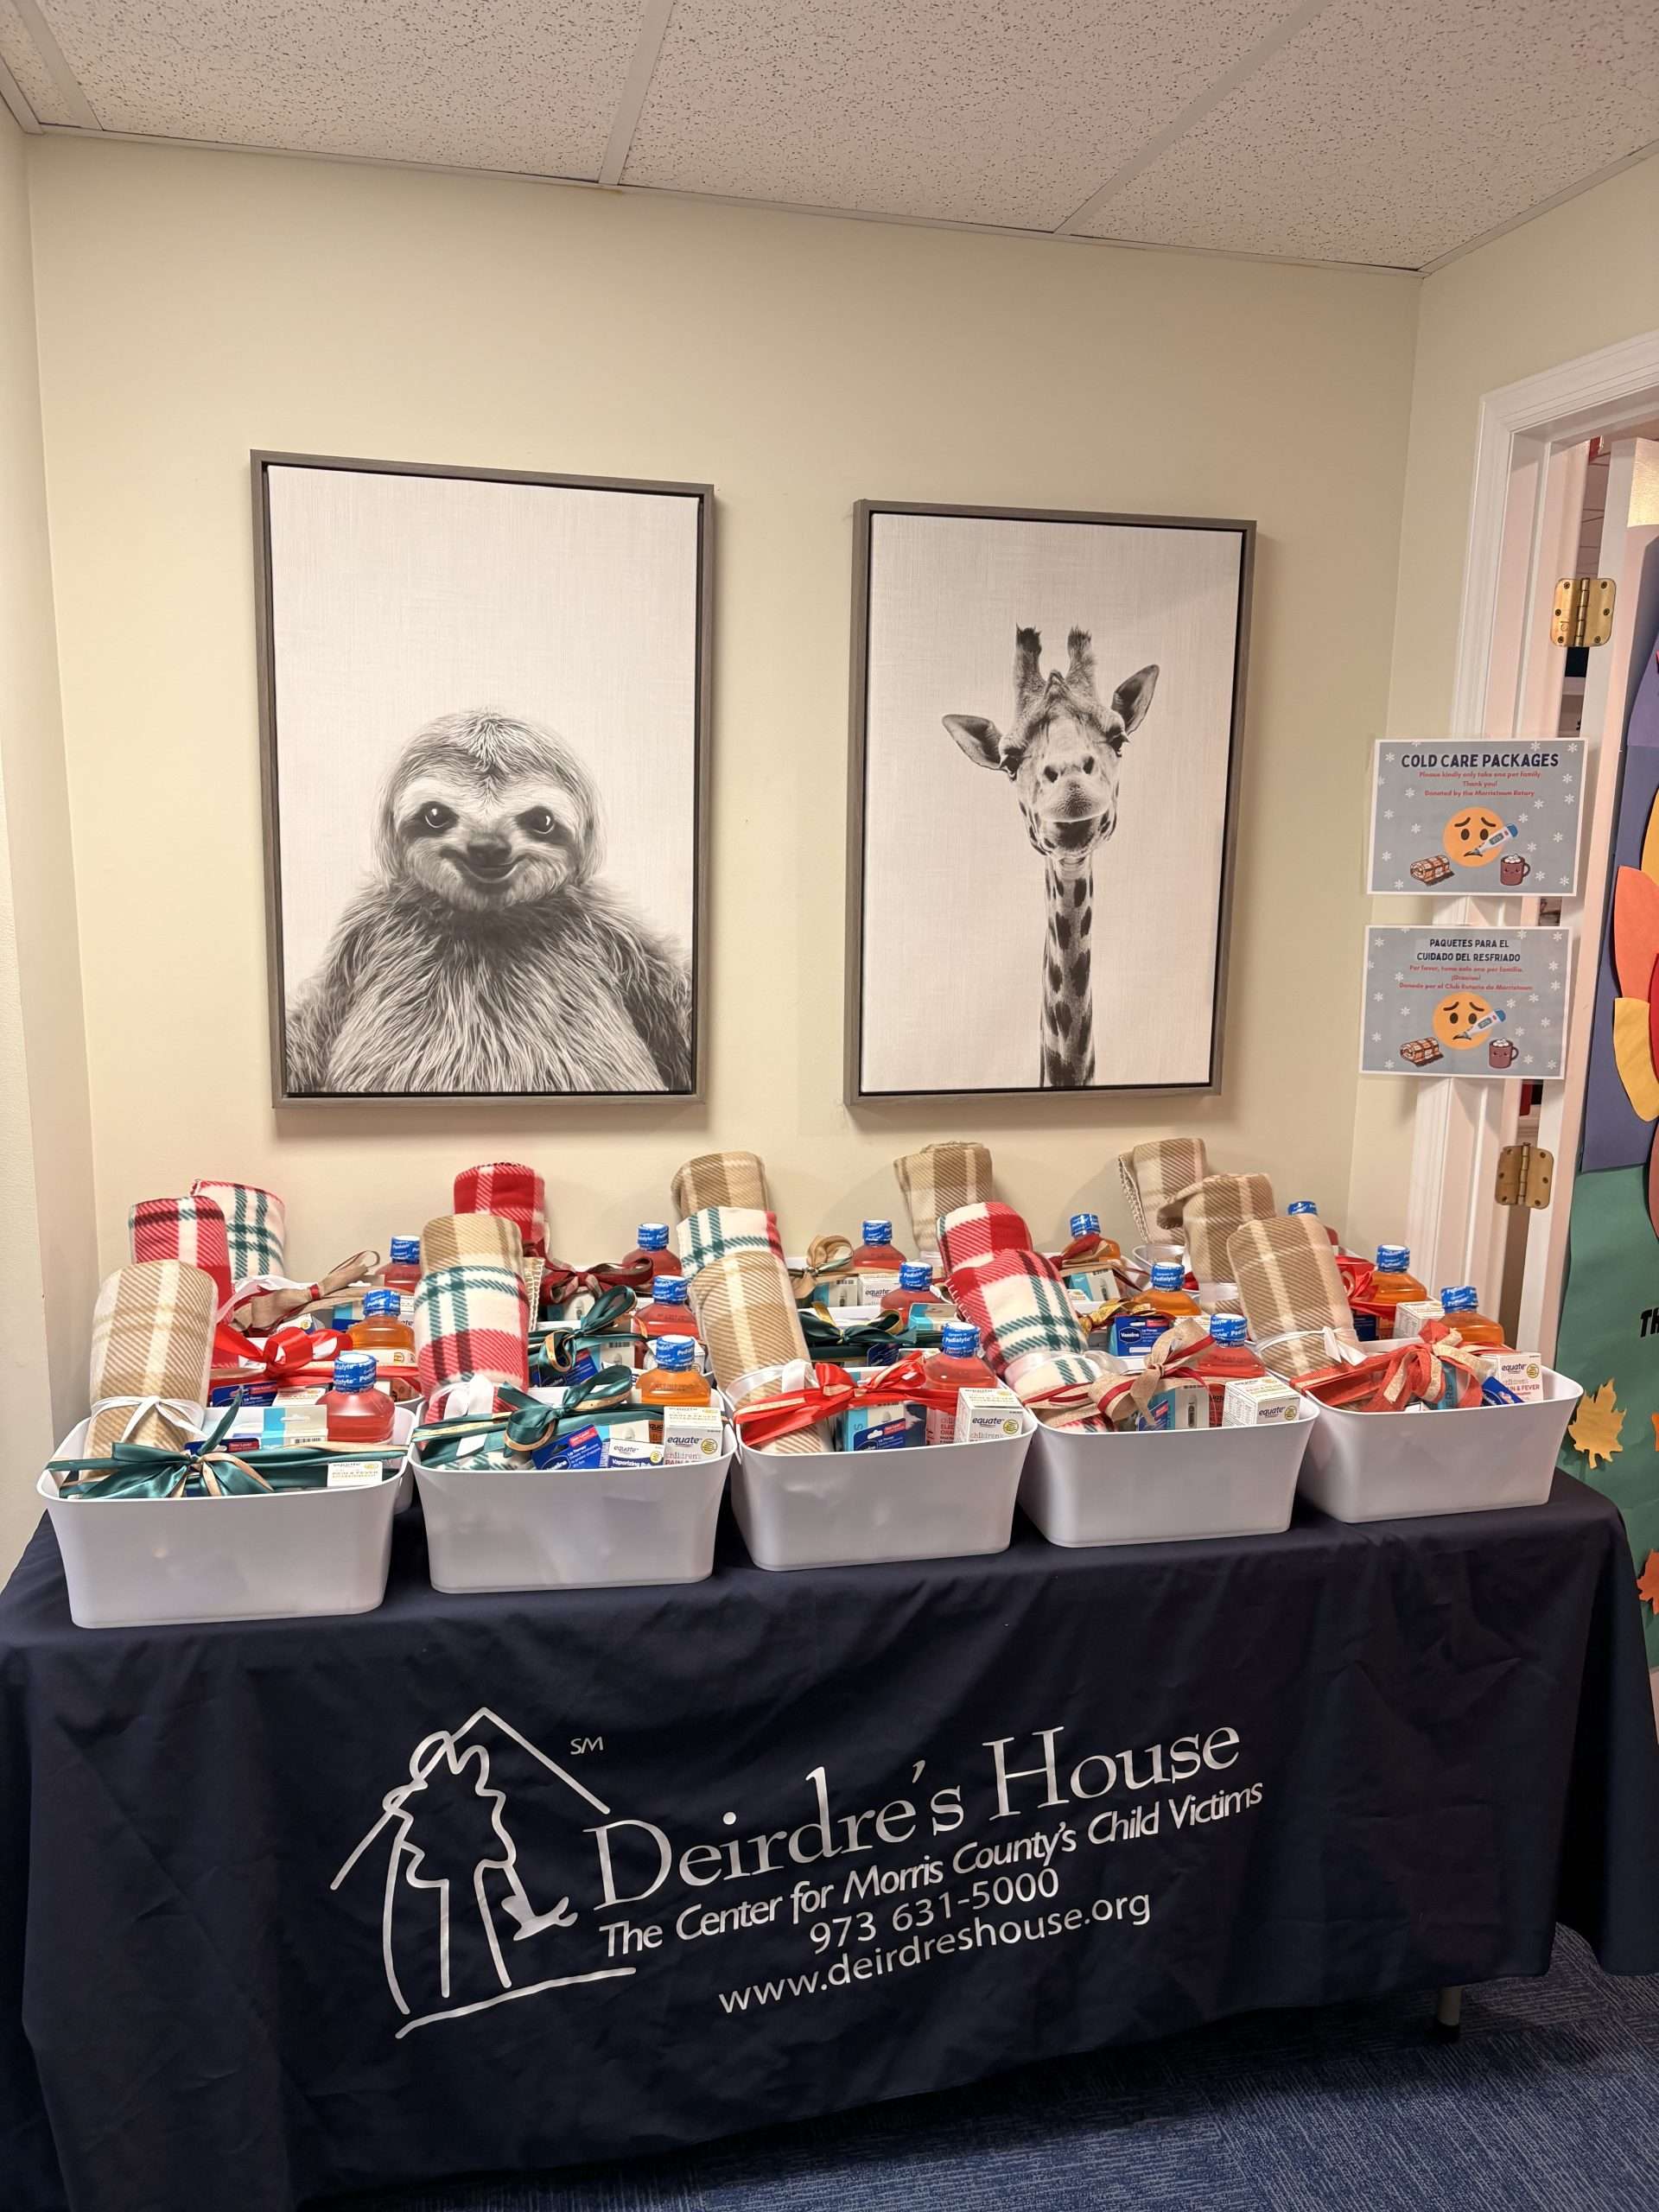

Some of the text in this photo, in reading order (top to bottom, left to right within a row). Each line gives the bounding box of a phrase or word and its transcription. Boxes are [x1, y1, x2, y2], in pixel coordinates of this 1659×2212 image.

[1402, 753, 1559, 767] COLD CARE PACKAGES
[1430, 938, 1473, 948] PAQUETES
[1475, 939, 1497, 948] PARA
[1416, 952, 1521, 962] CUIDADO DEL RESFRIADO
[1258, 1407, 1285, 1417] equate
[667, 1436, 701, 1445] equate
[570, 1736, 603, 1755] SM
[582, 1726, 1239, 1910] Deirdre's House
[599, 1782, 1263, 1957] The Center for Morris County's Child Victims
[810, 1867, 1059, 1955] 973 631-5000
[718, 1892, 1151, 2013] www.deirdreshouse.org
